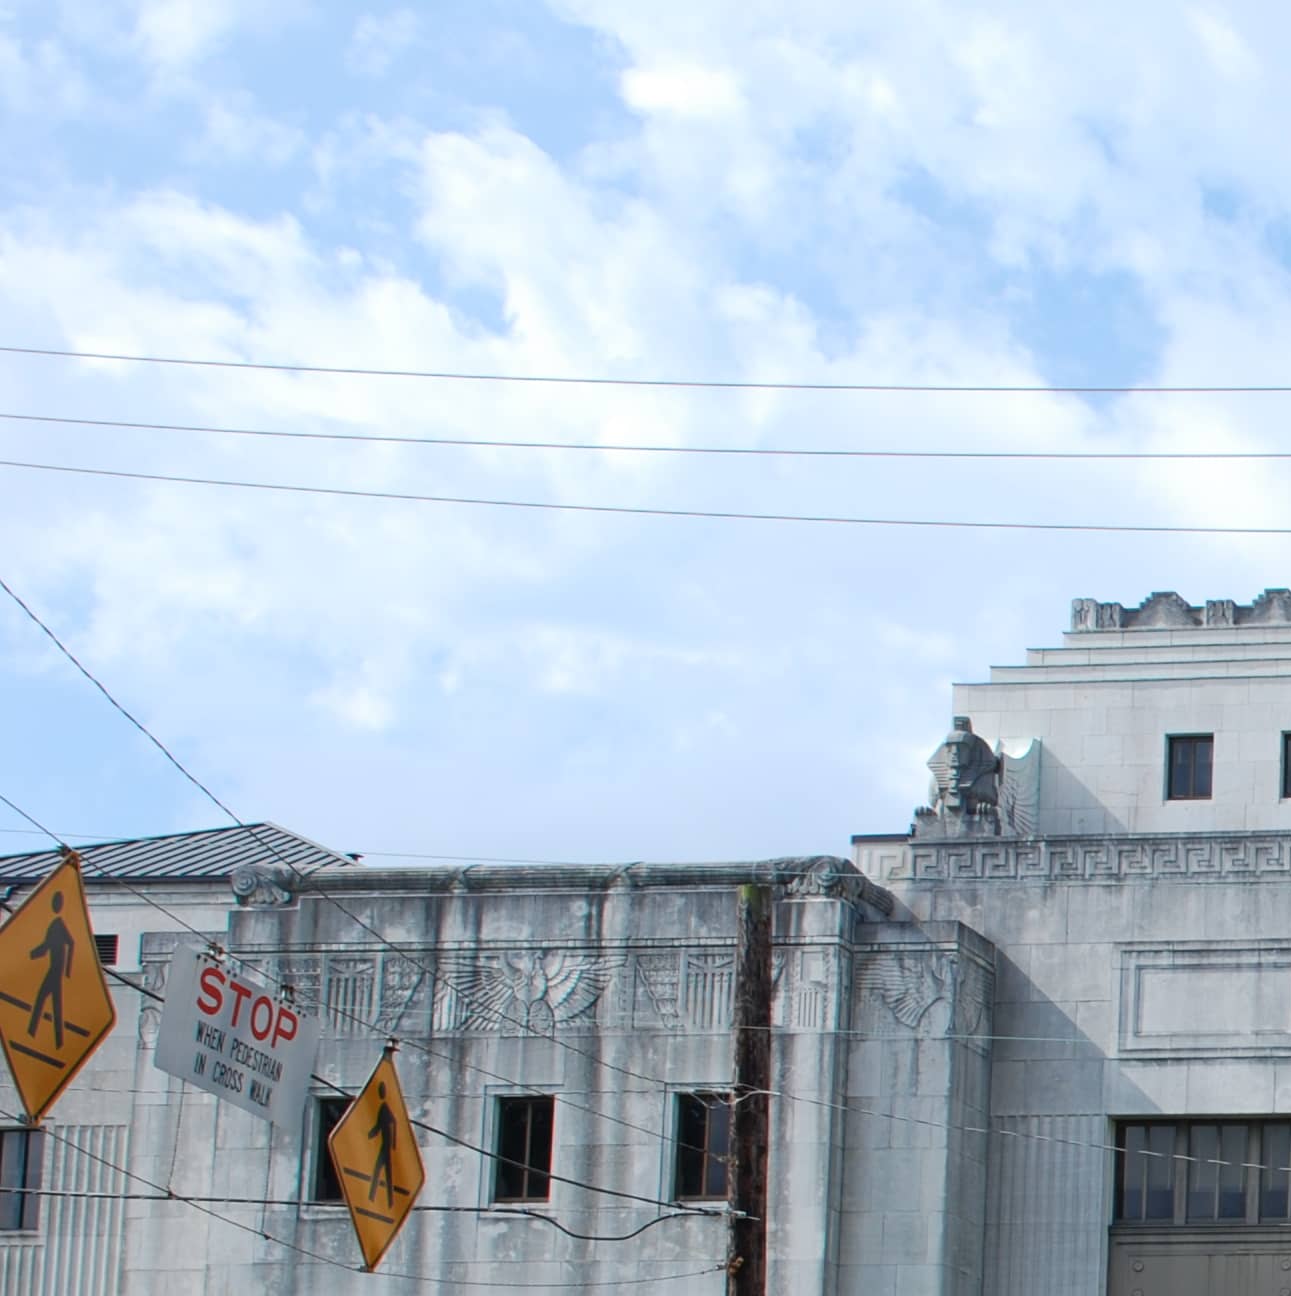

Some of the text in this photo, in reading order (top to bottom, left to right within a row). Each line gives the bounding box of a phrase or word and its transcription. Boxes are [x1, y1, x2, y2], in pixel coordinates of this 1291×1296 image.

[197, 967, 299, 1048] STOP
[196, 1020, 225, 1054] WHEN
[194, 1052, 207, 1076] IN
[212, 1060, 245, 1093] CROSS
[229, 1038, 283, 1083] PEDESTRIAN
